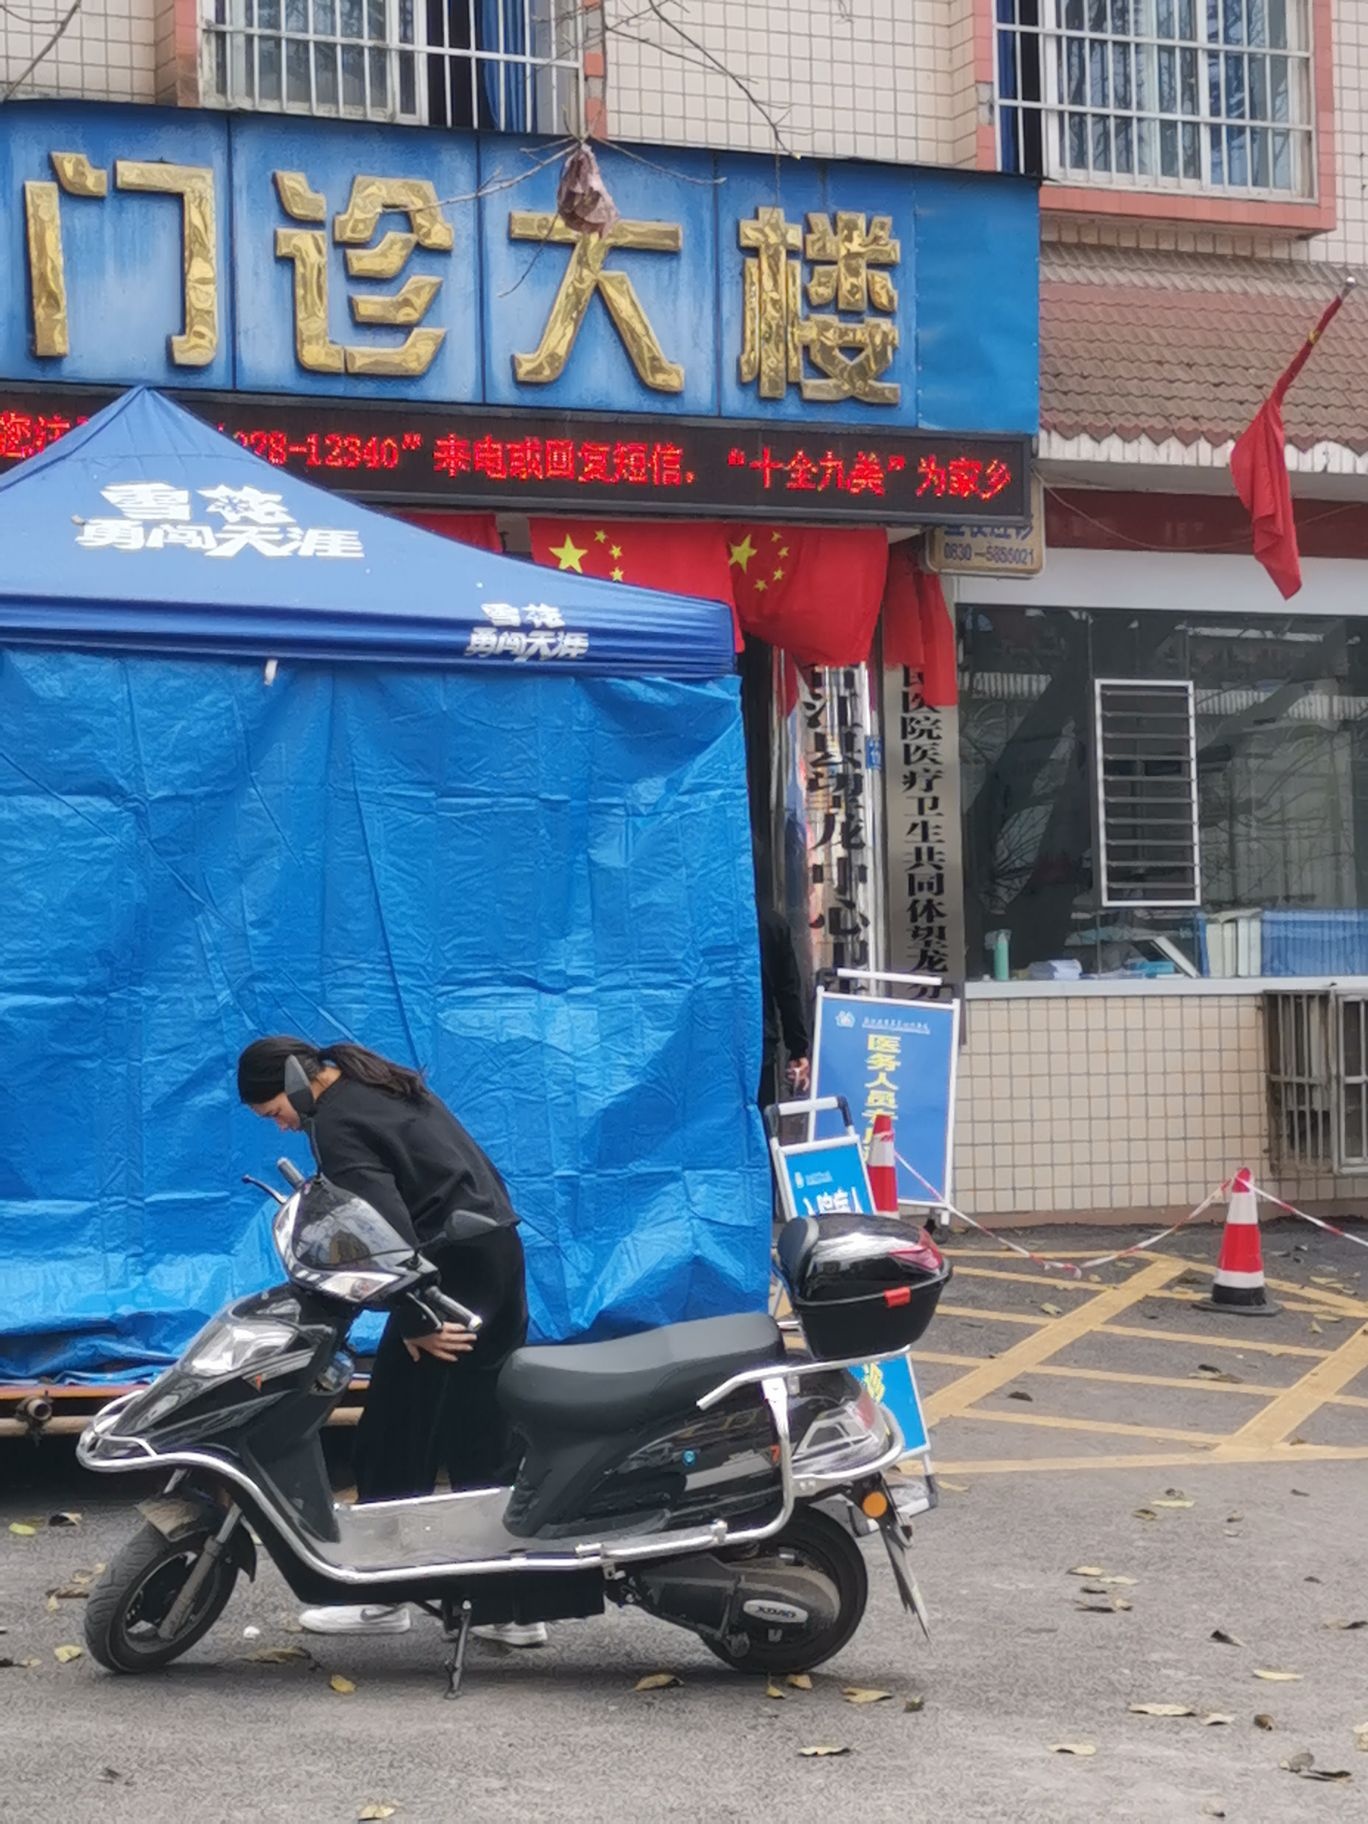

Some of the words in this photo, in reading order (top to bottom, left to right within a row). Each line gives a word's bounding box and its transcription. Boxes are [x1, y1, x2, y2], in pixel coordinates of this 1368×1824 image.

[24, 150, 903, 406] 门诊大楼
[100, 482, 297, 524] 雪花
[75, 517, 365, 558] 勇闯天涯
[480, 602, 566, 629] 雪花
[464, 626, 590, 662] 勇闯天涯
